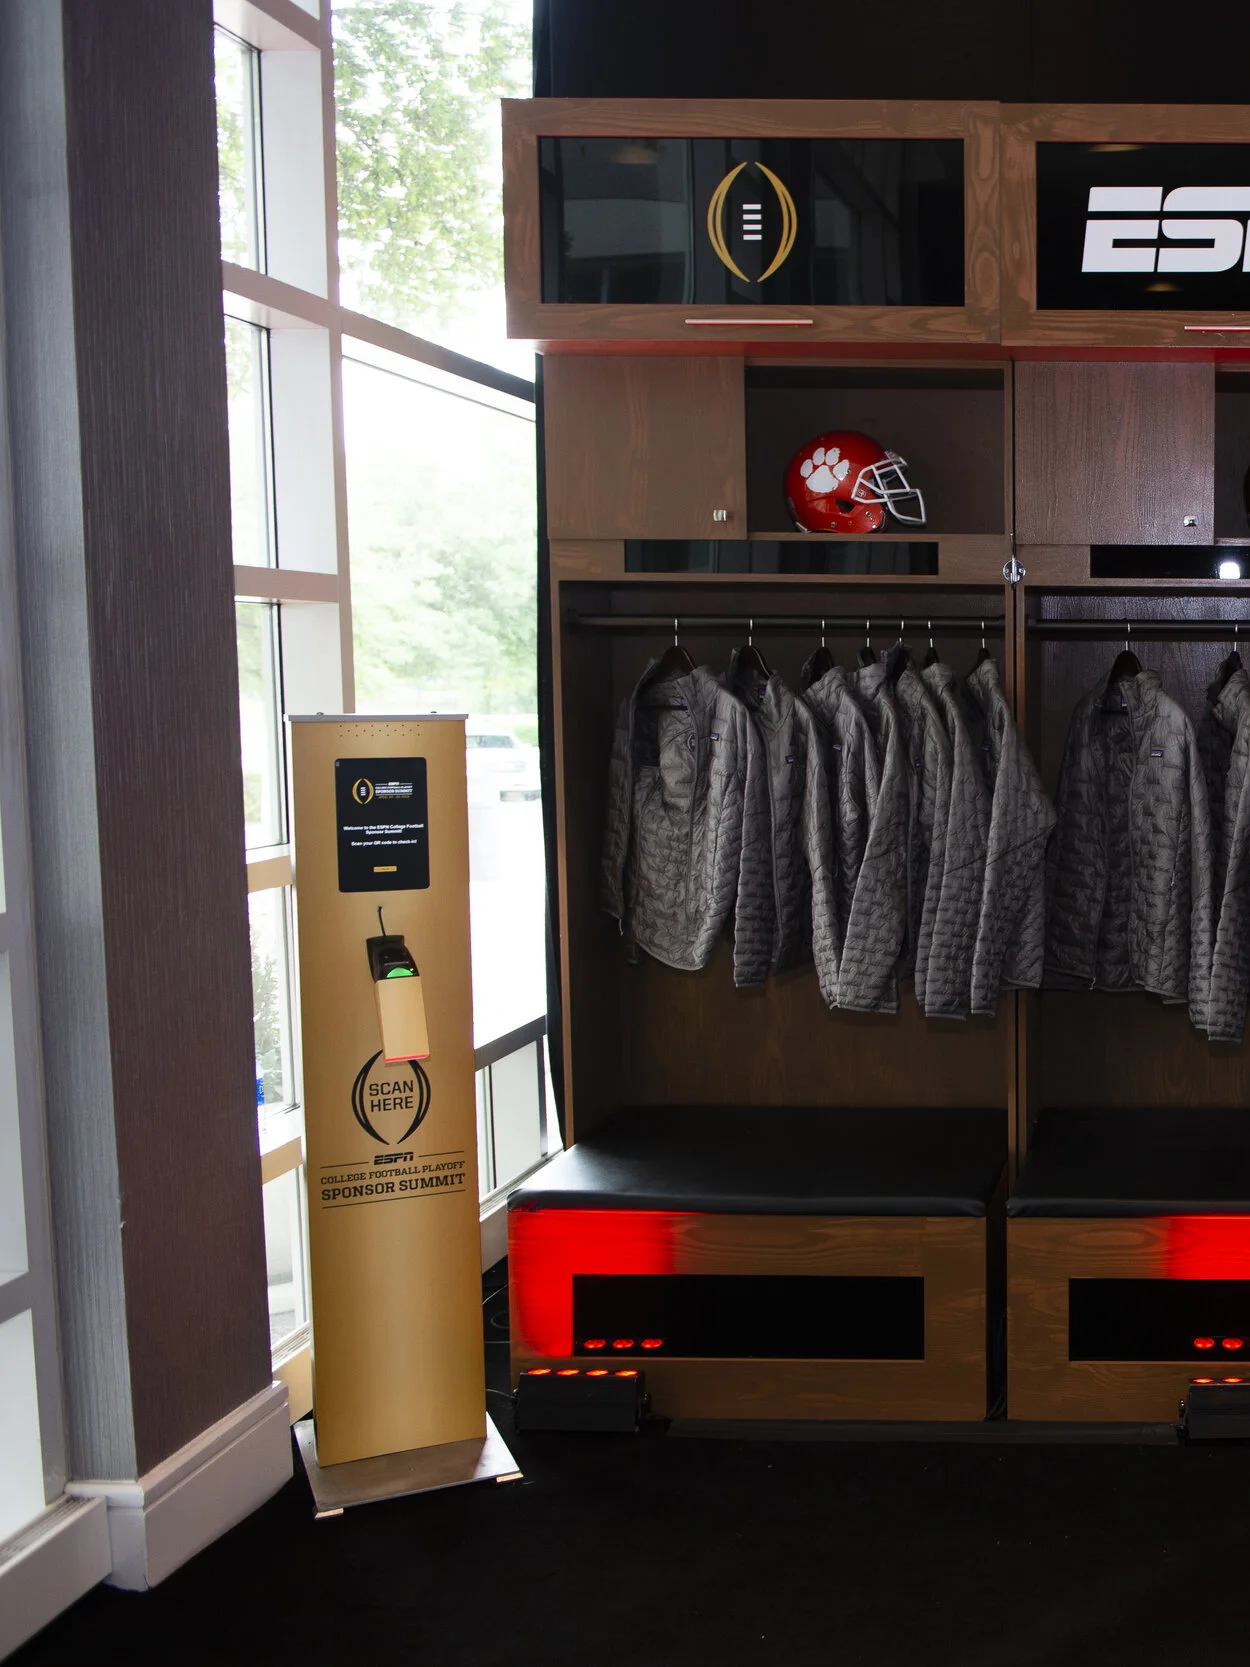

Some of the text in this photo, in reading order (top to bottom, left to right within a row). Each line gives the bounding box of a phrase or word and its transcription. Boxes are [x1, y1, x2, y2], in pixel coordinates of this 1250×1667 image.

[369, 1080, 414, 1097] SCAN
[370, 1096, 414, 1113] HERE
[374, 1151, 414, 1166] ESPN
[320, 1160, 466, 1185] COLLEGE FOOTBALL PLAYOFF
[321, 1173, 466, 1201] SPONSOR SUMMIT
